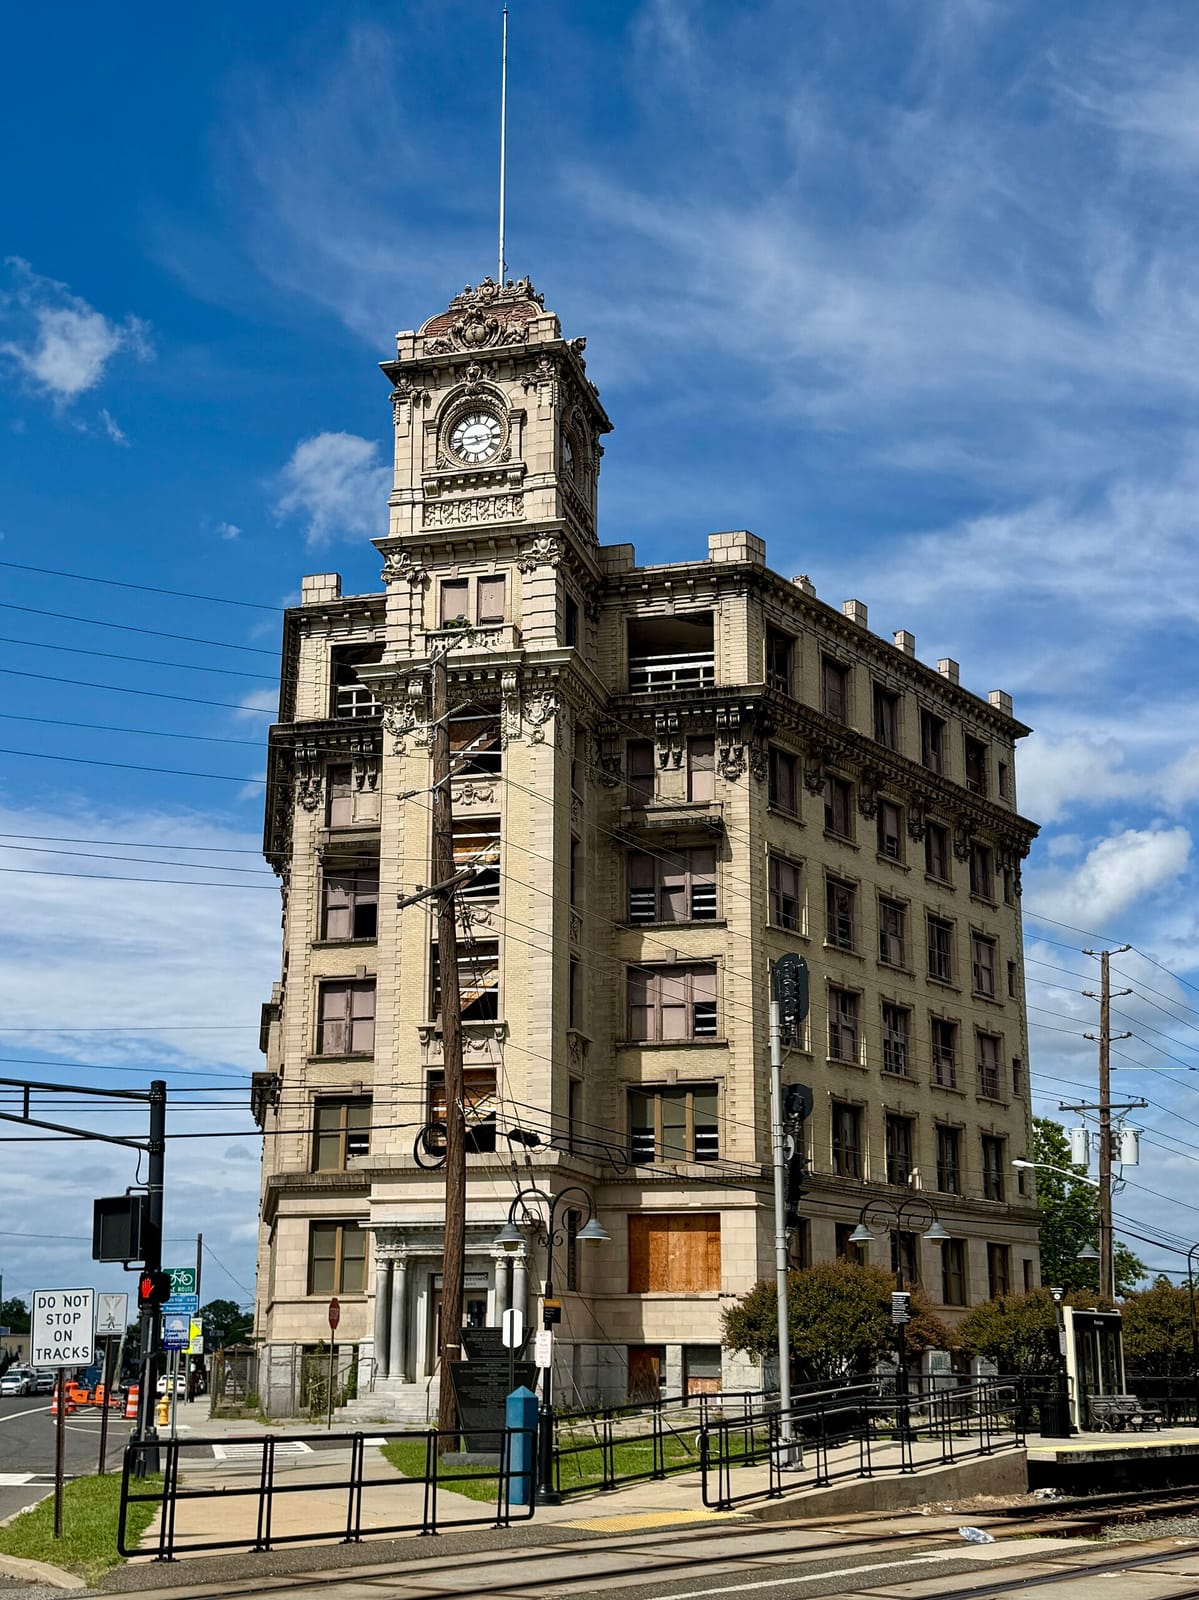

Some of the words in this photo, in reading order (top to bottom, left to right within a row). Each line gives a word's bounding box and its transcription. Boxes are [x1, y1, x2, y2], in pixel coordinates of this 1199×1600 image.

[38, 1296, 56, 1309] DO
[63, 1295, 89, 1308] NOT
[46, 1312, 81, 1325] STOP
[54, 1330, 72, 1342] ON
[35, 1346, 89, 1360] TRACKS
